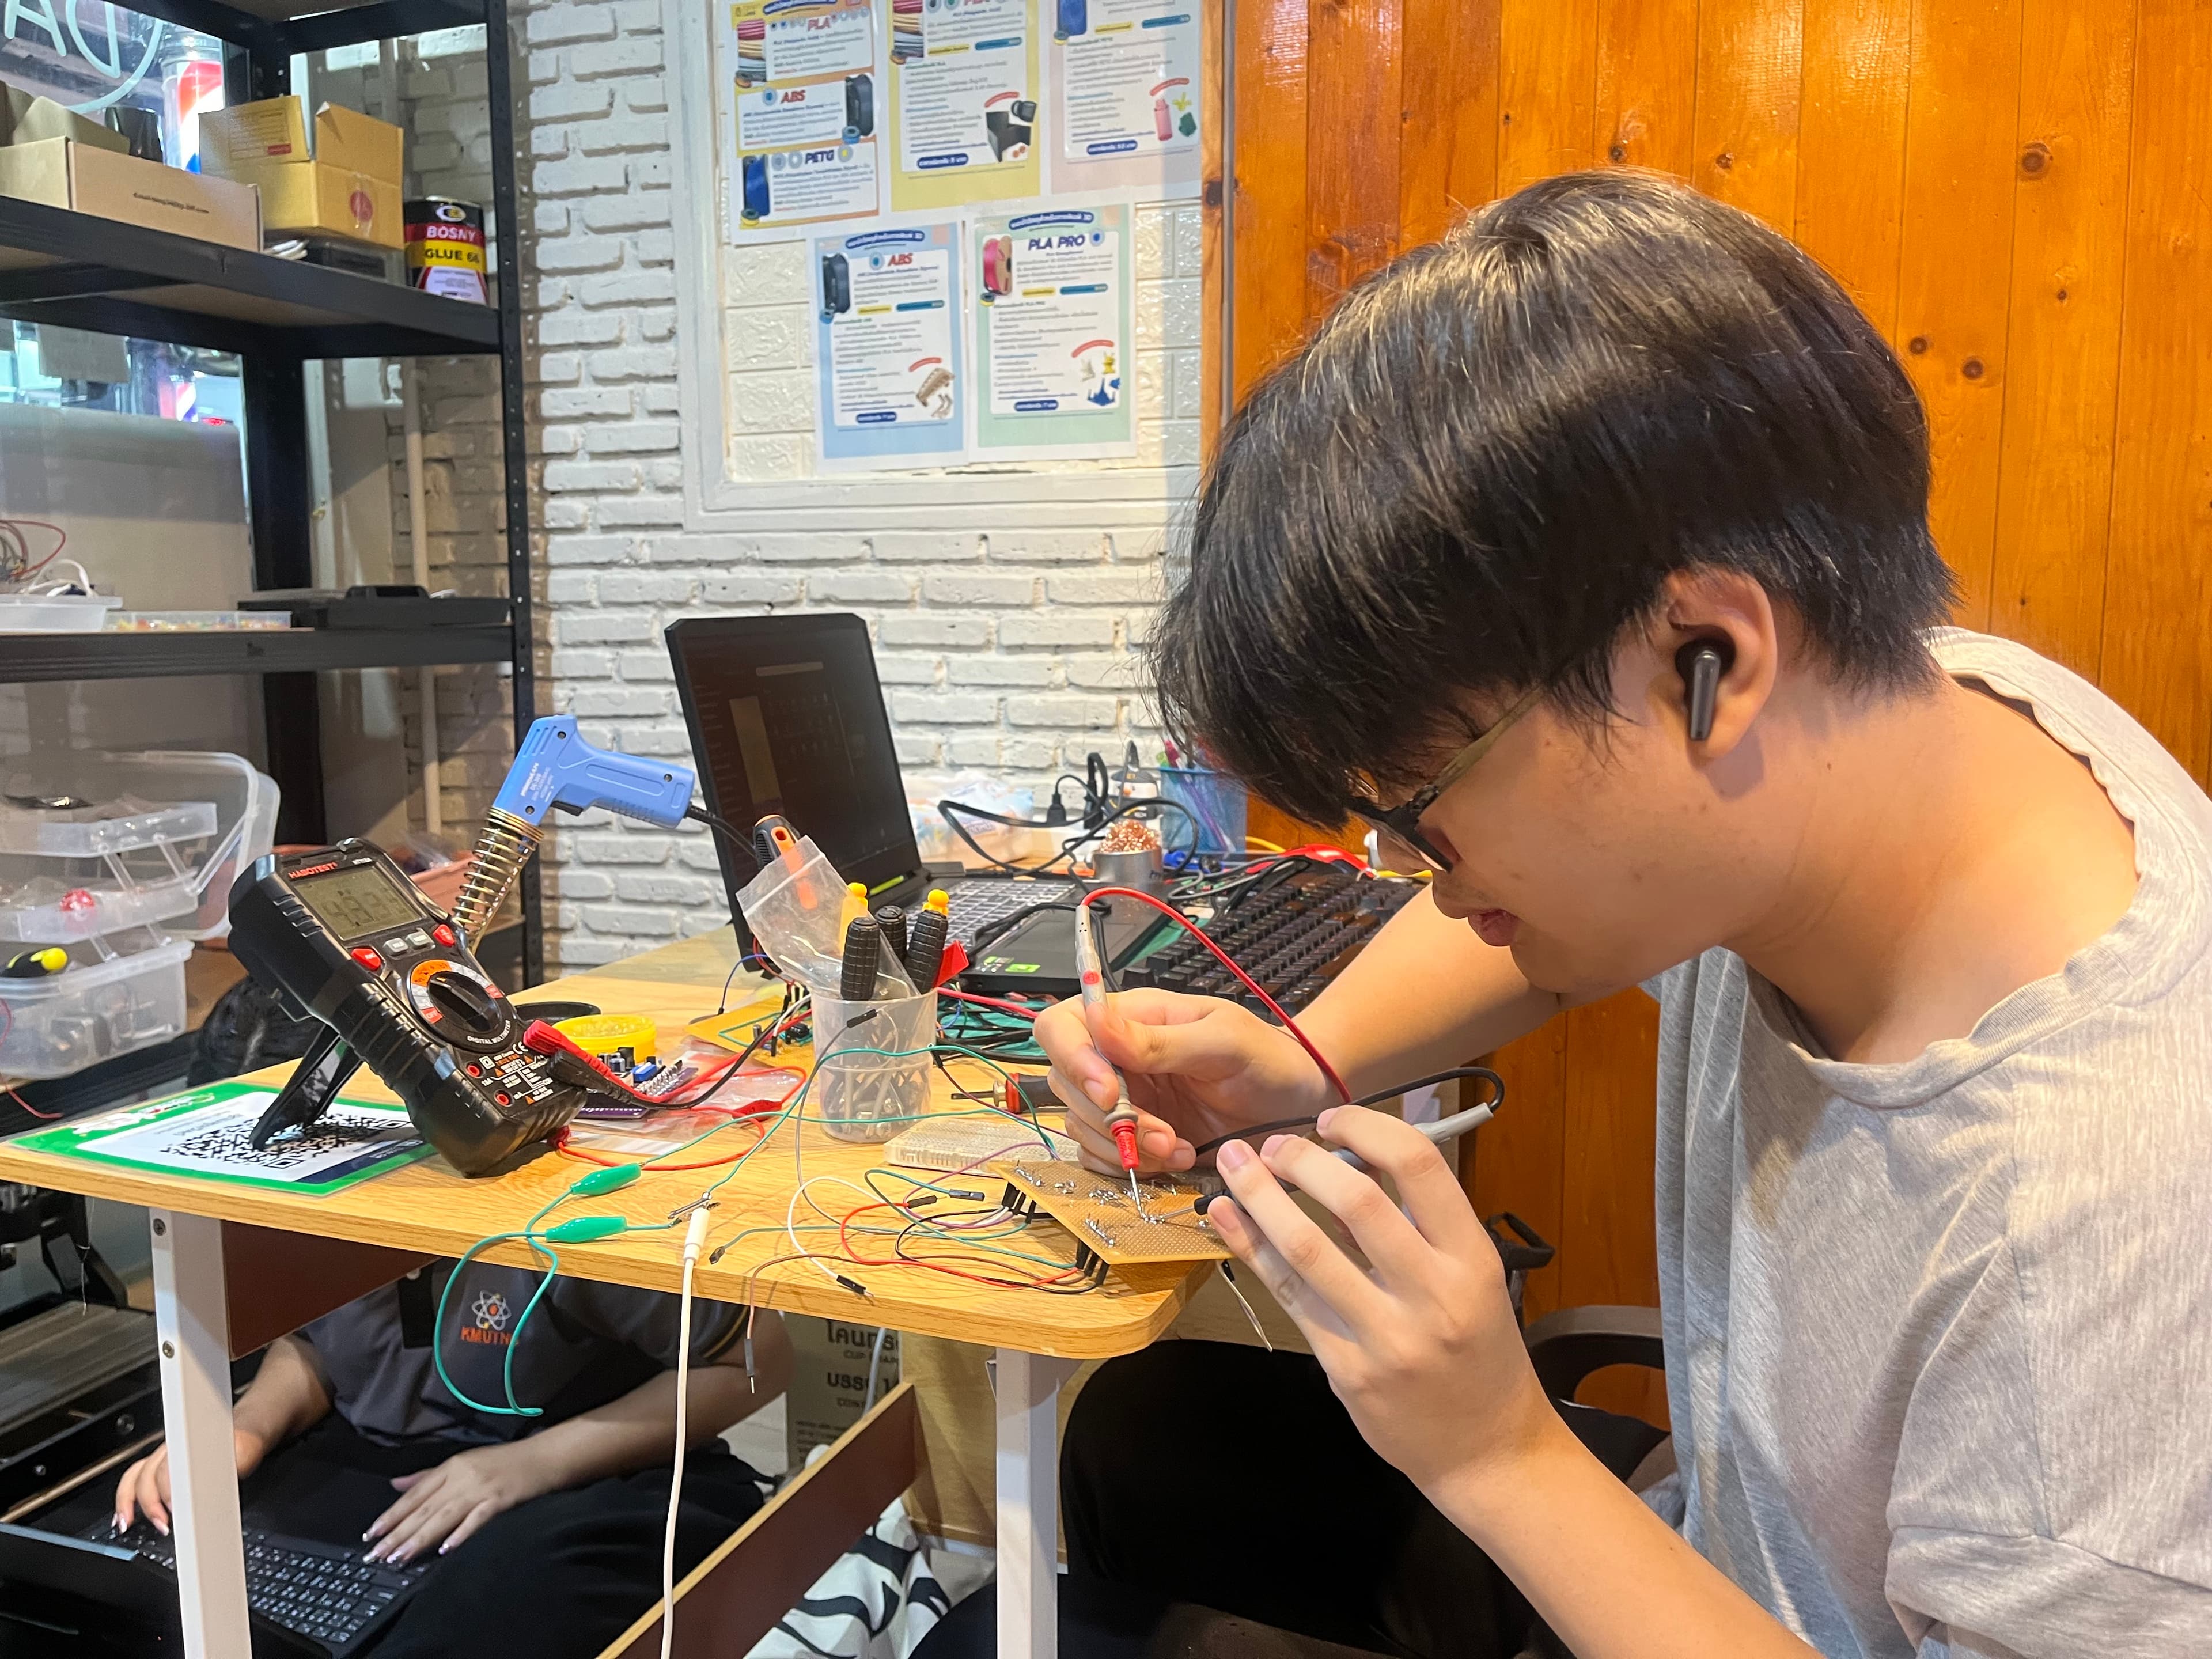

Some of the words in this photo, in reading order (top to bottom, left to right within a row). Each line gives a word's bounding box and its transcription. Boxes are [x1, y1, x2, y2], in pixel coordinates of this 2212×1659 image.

[807, 17, 831, 31] PLA
[781, 90, 805, 104] ABS
[805, 150, 834, 164] PETG
[426, 225, 476, 242] BOSNY
[1028, 237, 1053, 251] PLA
[1058, 234, 1085, 248] PRO
[424, 248, 463, 260] GLUE
[888, 253, 913, 267] ABS
[461, 1327, 520, 1346] KMUTN
